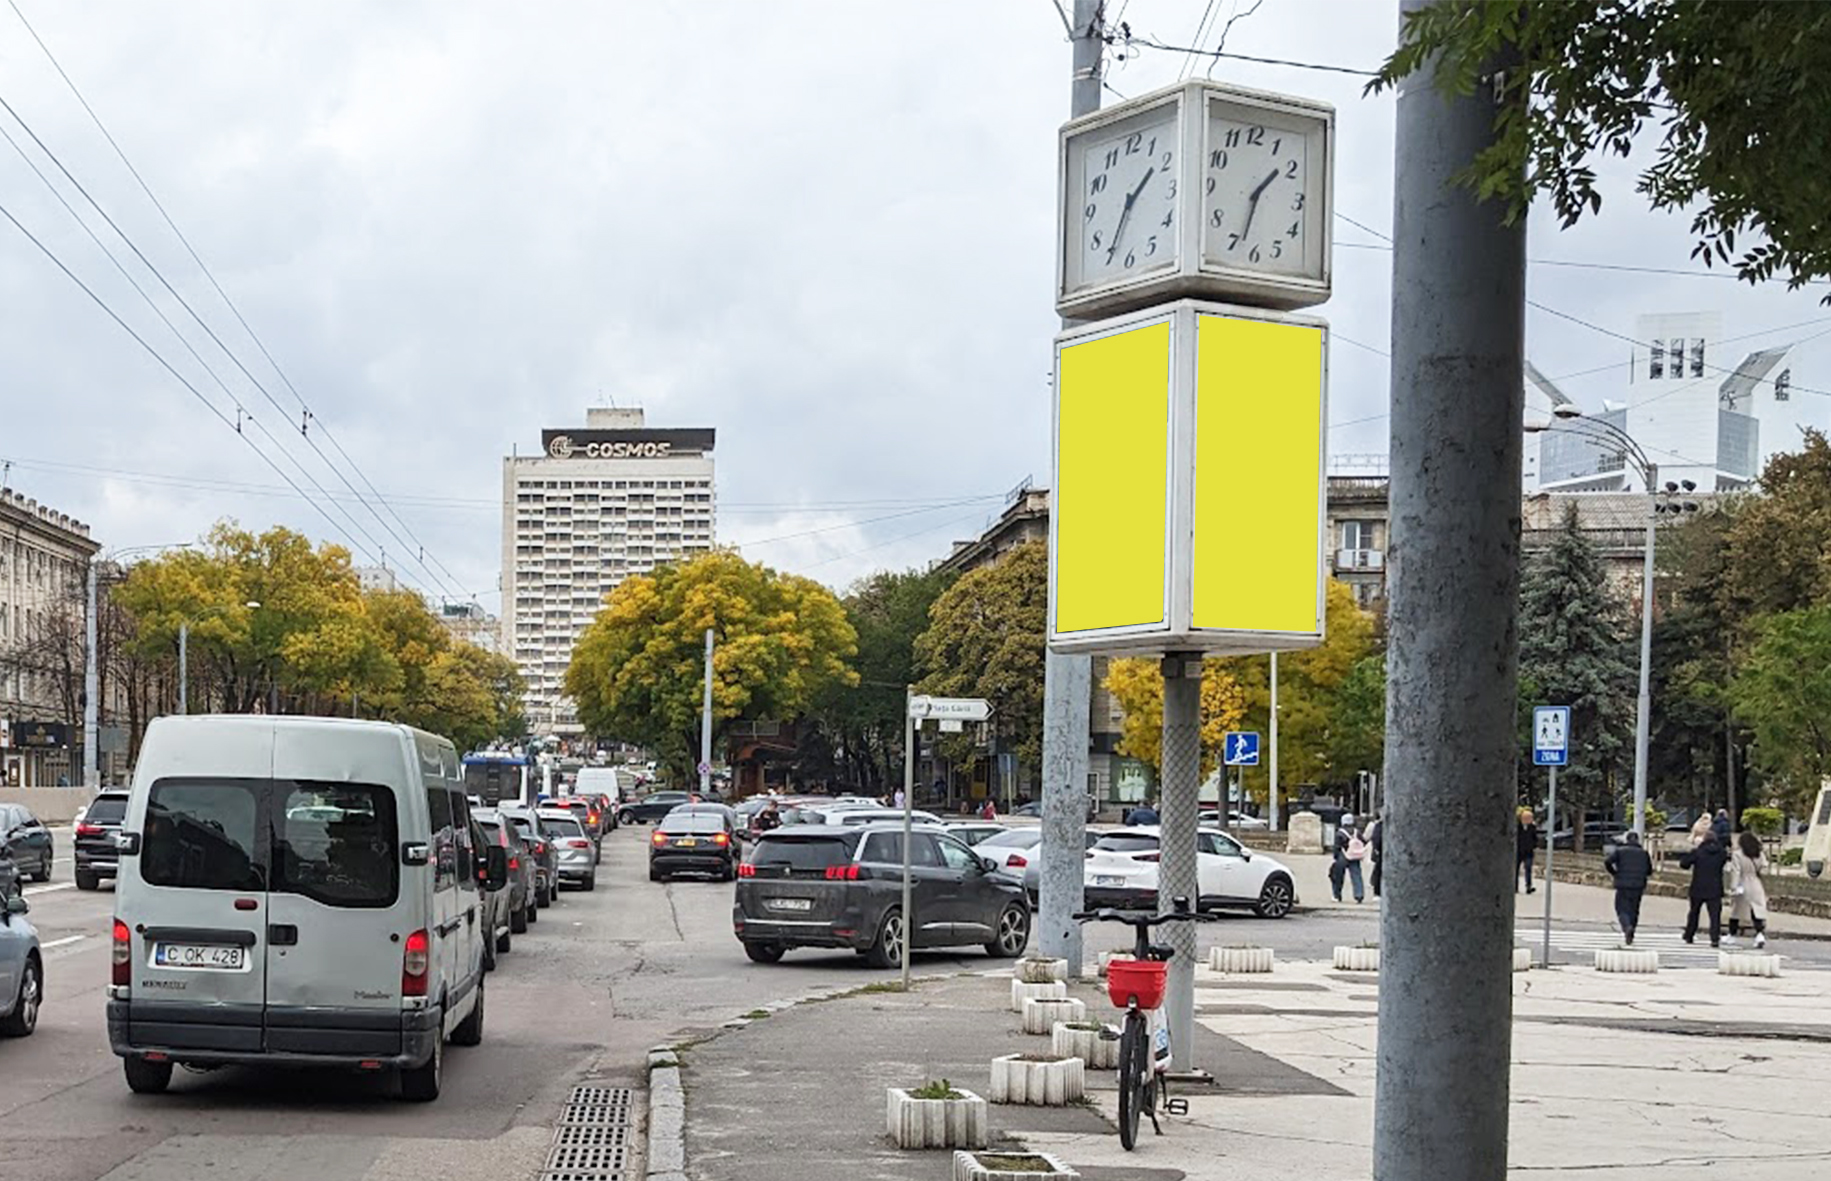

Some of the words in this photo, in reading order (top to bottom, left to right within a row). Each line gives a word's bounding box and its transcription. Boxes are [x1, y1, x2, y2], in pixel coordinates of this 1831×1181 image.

[1125, 133, 1142, 156] 12
[1225, 128, 1241, 148] 11
[1246, 126, 1265, 146] 12
[1148, 137, 1157, 157] 1
[1271, 138, 1282, 156] 1
[1105, 148, 1119, 170] 11
[1160, 152, 1172, 173] 2
[1209, 148, 1228, 170] 10
[1285, 160, 1298, 179] 2
[1090, 174, 1107, 196] 10
[1166, 179, 1177, 200] 3
[1291, 192, 1305, 211] 3
[1085, 204, 1096, 224] 9
[1161, 209, 1174, 229] 4
[1210, 208, 1224, 228] 8
[1286, 220, 1299, 239] 4
[1091, 230, 1103, 251] 8
[1145, 236, 1157, 257] 5
[1227, 233, 1240, 251] 7
[1269, 240, 1282, 259] 5
[1124, 248, 1135, 269] 6
[1248, 244, 1260, 264] 6
[586, 442, 671, 458] COSMOS
[168, 946, 178, 961] C
[212, 949, 239, 965] 428
